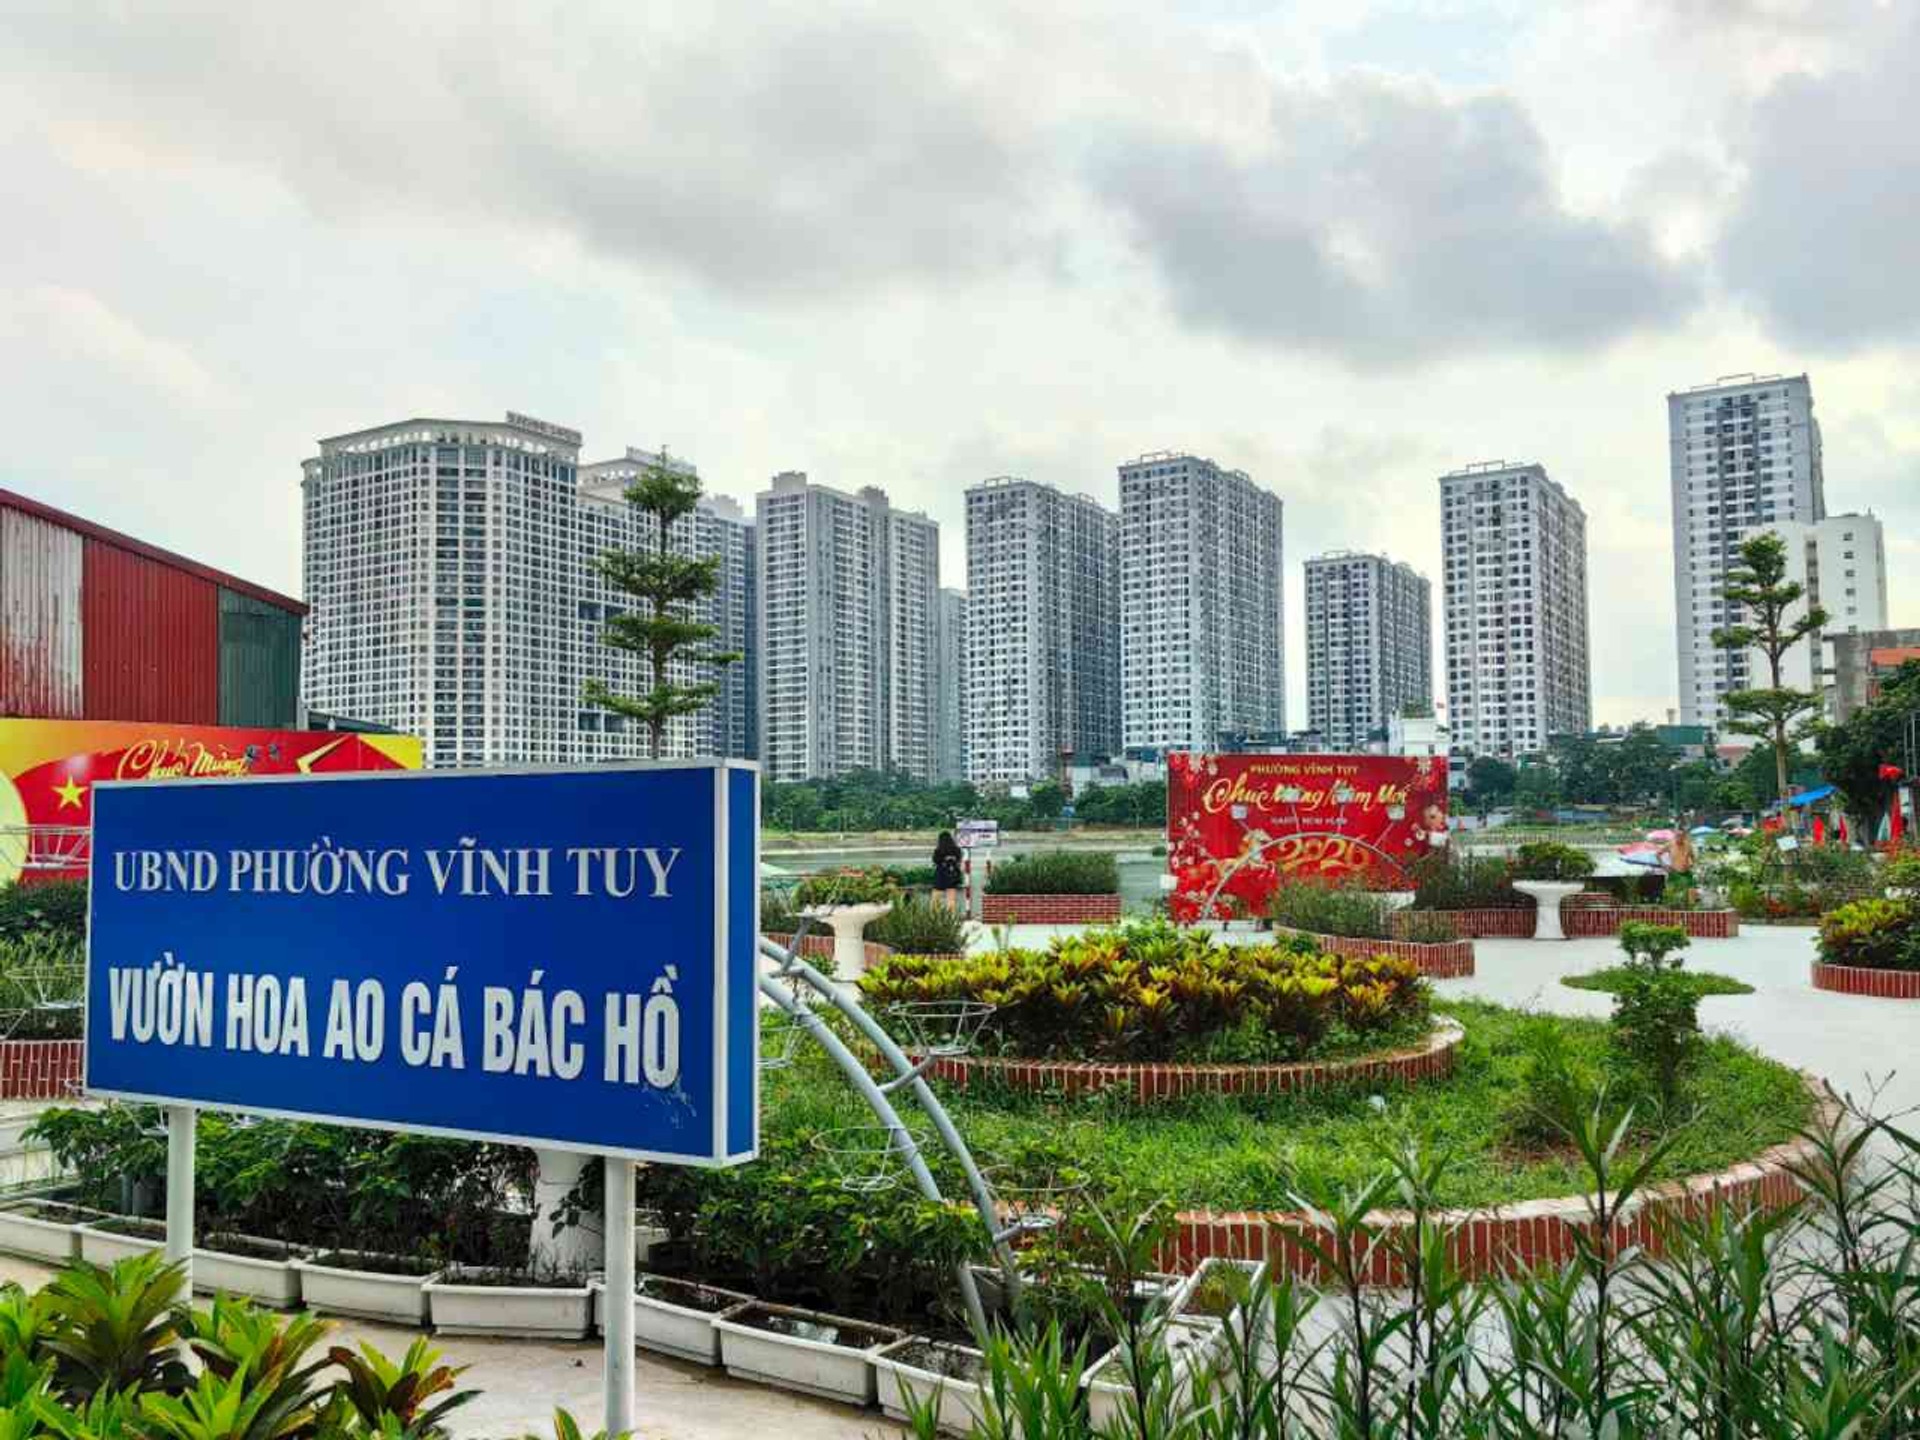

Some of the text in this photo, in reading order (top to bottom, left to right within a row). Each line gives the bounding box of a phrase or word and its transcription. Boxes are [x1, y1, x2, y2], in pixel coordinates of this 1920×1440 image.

[1201, 772, 1271, 813] Chúc
[1303, 762, 1334, 775] VĨNH
[113, 836, 684, 898] UBND PHƯỜNG VĨNH TUY
[108, 950, 680, 1089] VƯỜN HOA AO CÁ BÁC HỒ
